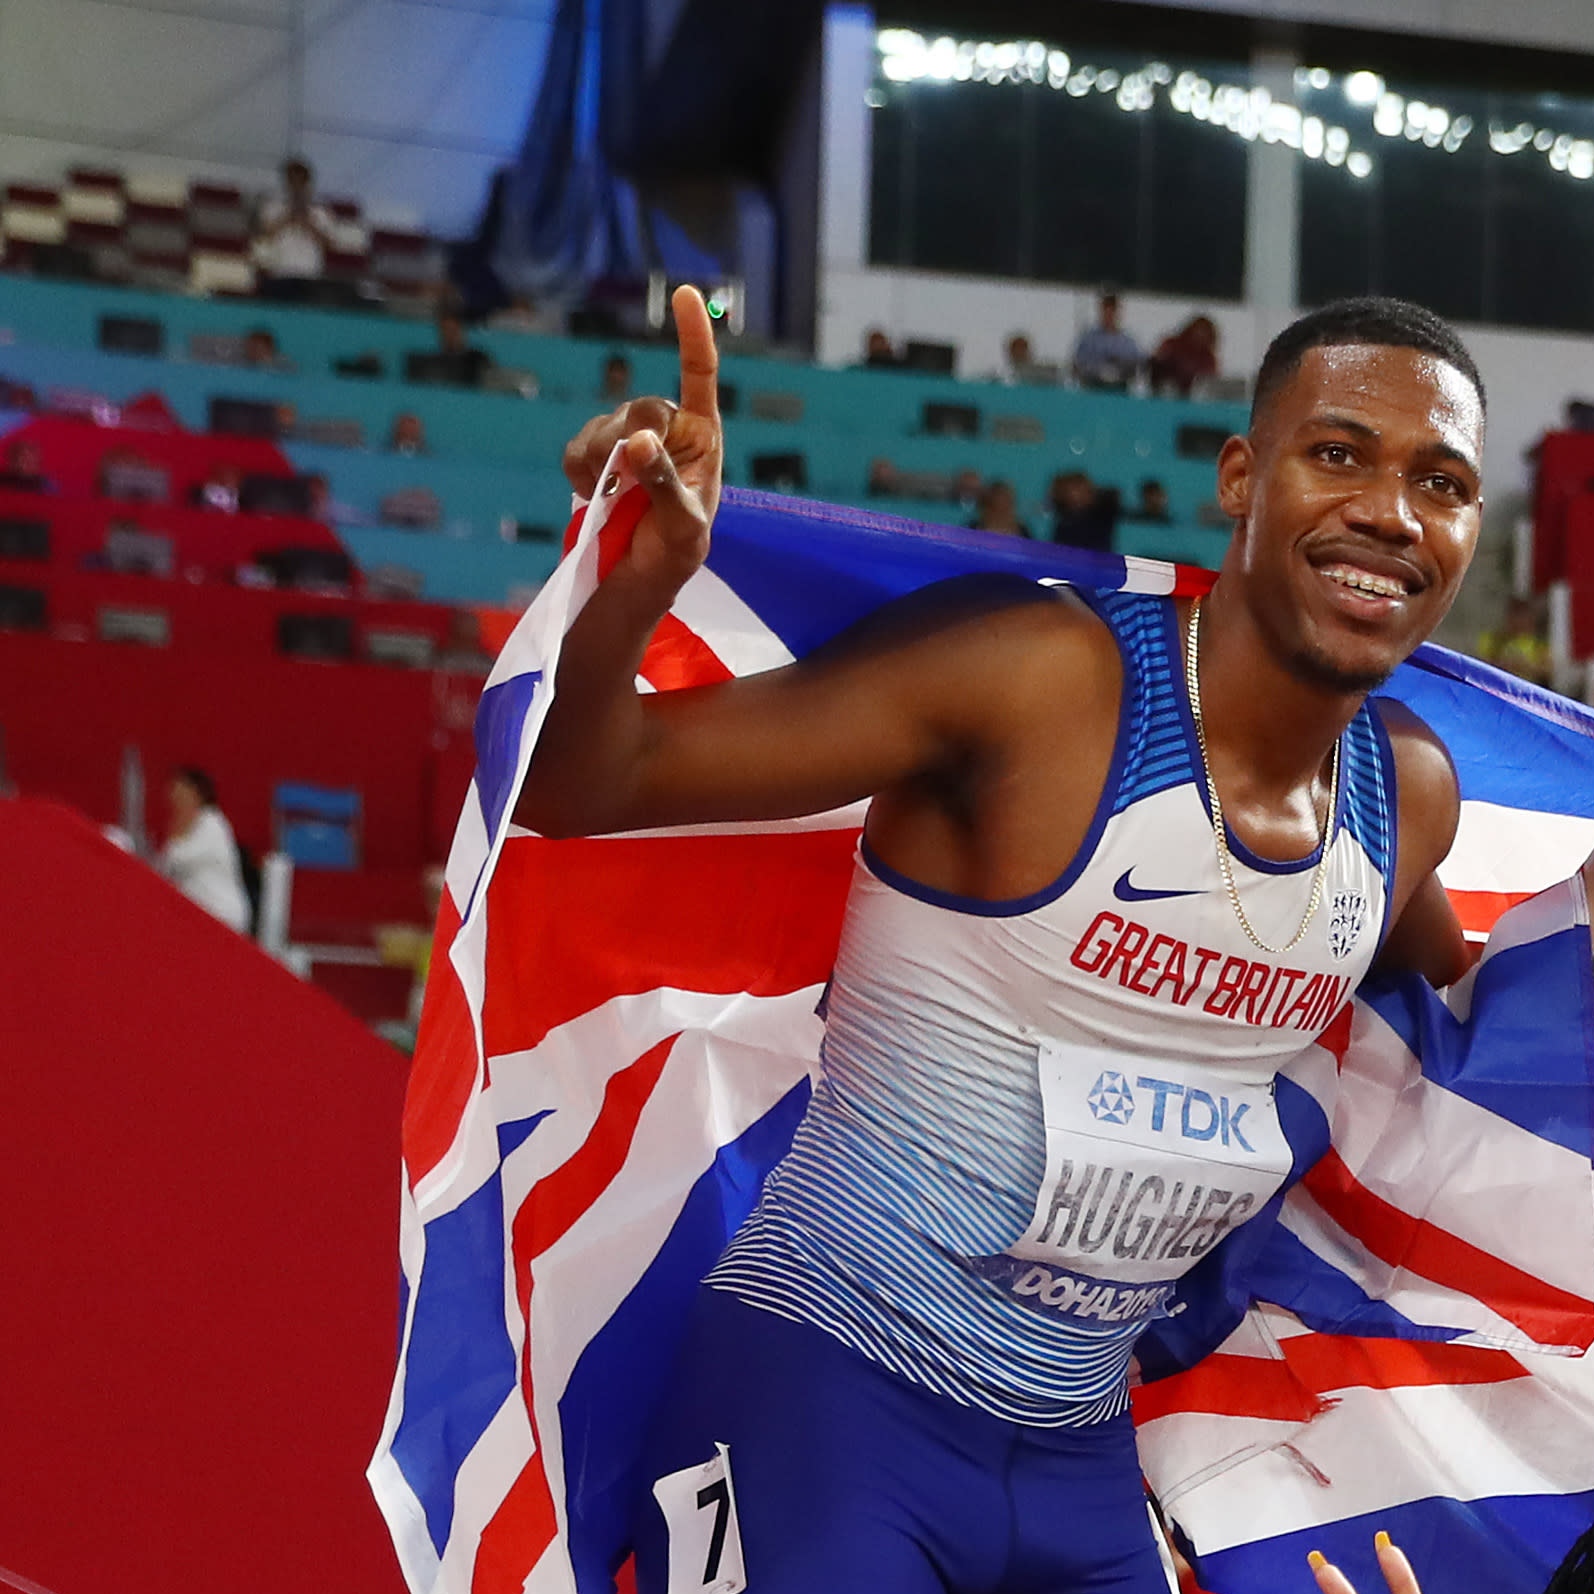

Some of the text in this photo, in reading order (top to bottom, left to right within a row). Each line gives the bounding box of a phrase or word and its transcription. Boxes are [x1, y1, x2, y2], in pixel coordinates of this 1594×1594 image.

[1071, 911, 1351, 1031] GREAT BRITAIN
[1136, 1075, 1256, 1153] TDK
[1036, 1160, 1255, 1261] HUGHES
[696, 1477, 730, 1585] 7
